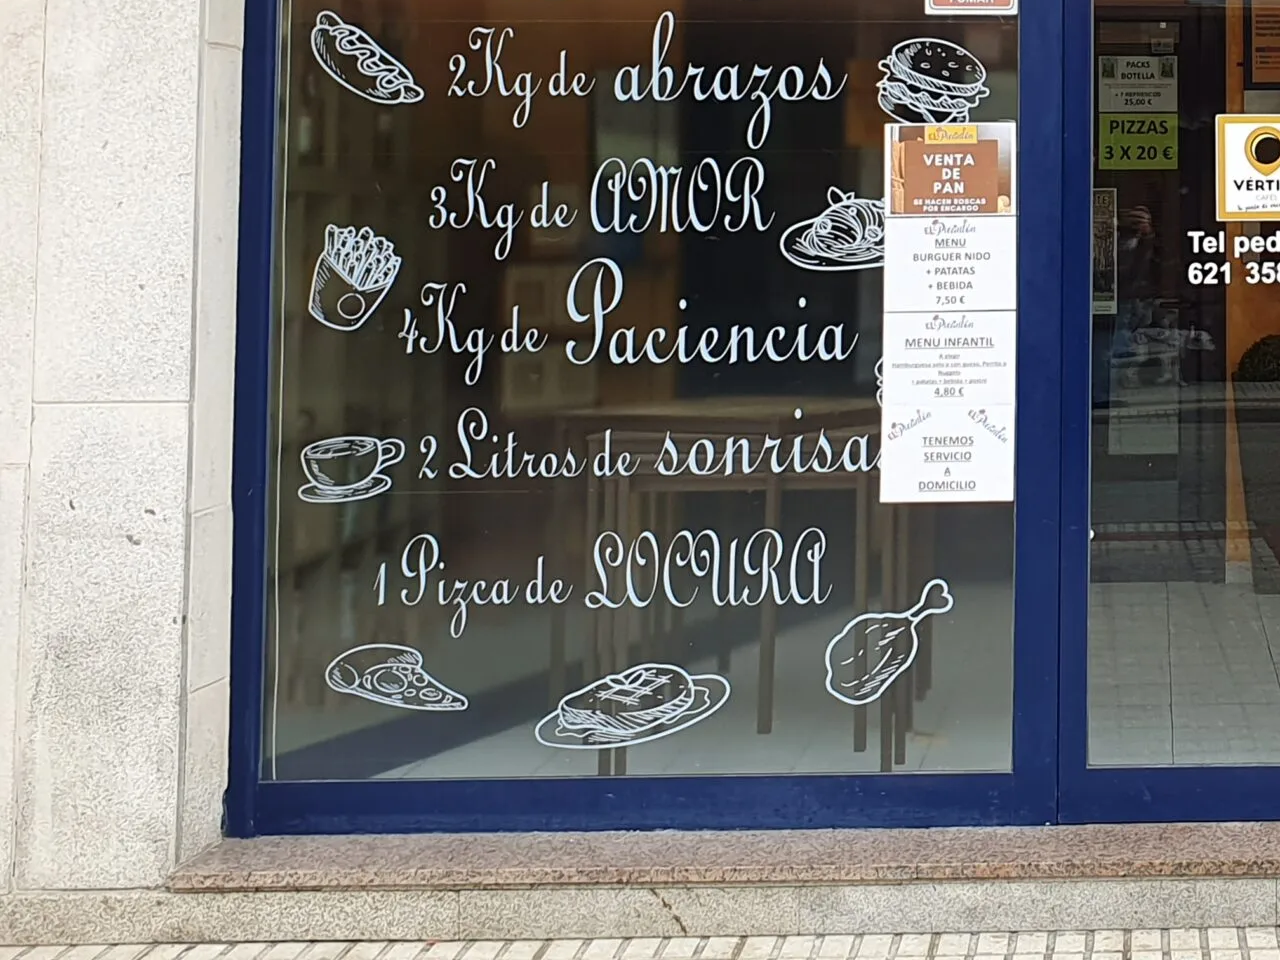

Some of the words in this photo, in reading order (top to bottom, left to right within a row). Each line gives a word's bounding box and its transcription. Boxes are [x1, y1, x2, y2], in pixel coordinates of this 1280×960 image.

[548, 50, 596, 96] de
[613, 10, 848, 150] abrazos
[1110, 120, 1169, 135] PIZZAS
[1104, 146, 1114, 160] 3
[1120, 146, 1131, 160] X
[1136, 146, 1157, 160] 20
[1162, 146, 1174, 160] €
[923, 154, 974, 166] VENTA
[942, 168, 960, 180] DE
[933, 182, 964, 194] PAN
[530, 182, 578, 229] de
[590, 156, 775, 233] AMOR
[913, 198, 924, 206] SE
[935, 239, 966, 247] MENU
[1187, 231, 1225, 254] Tel
[913, 253, 961, 262] BURGUER
[965, 252, 991, 260] NIDO
[934, 267, 975, 275] PATATAS
[1187, 262, 1231, 285] 621
[937, 281, 973, 290] BEBIDA
[936, 296, 957, 305] 7,50
[960, 296, 965, 304] €
[500, 305, 548, 354] de
[564, 256, 859, 366] Paciencia
[905, 338, 941, 348] MENU
[944, 337, 995, 348] INFANTIL
[934, 387, 956, 397] 4,80
[958, 387, 964, 396] €
[418, 435, 438, 479] 2
[448, 407, 587, 479] Litros
[593, 429, 641, 477] de
[653, 408, 881, 477] sonrisa
[922, 436, 975, 446] TENEMOS
[923, 451, 972, 461] SERVICIO
[944, 467, 951, 477] A
[918, 481, 976, 491] DOMICILIO
[372, 562, 387, 606] 1
[400, 533, 520, 638] Pizca
[525, 556, 573, 606] de
[584, 527, 833, 609] LOCURA
